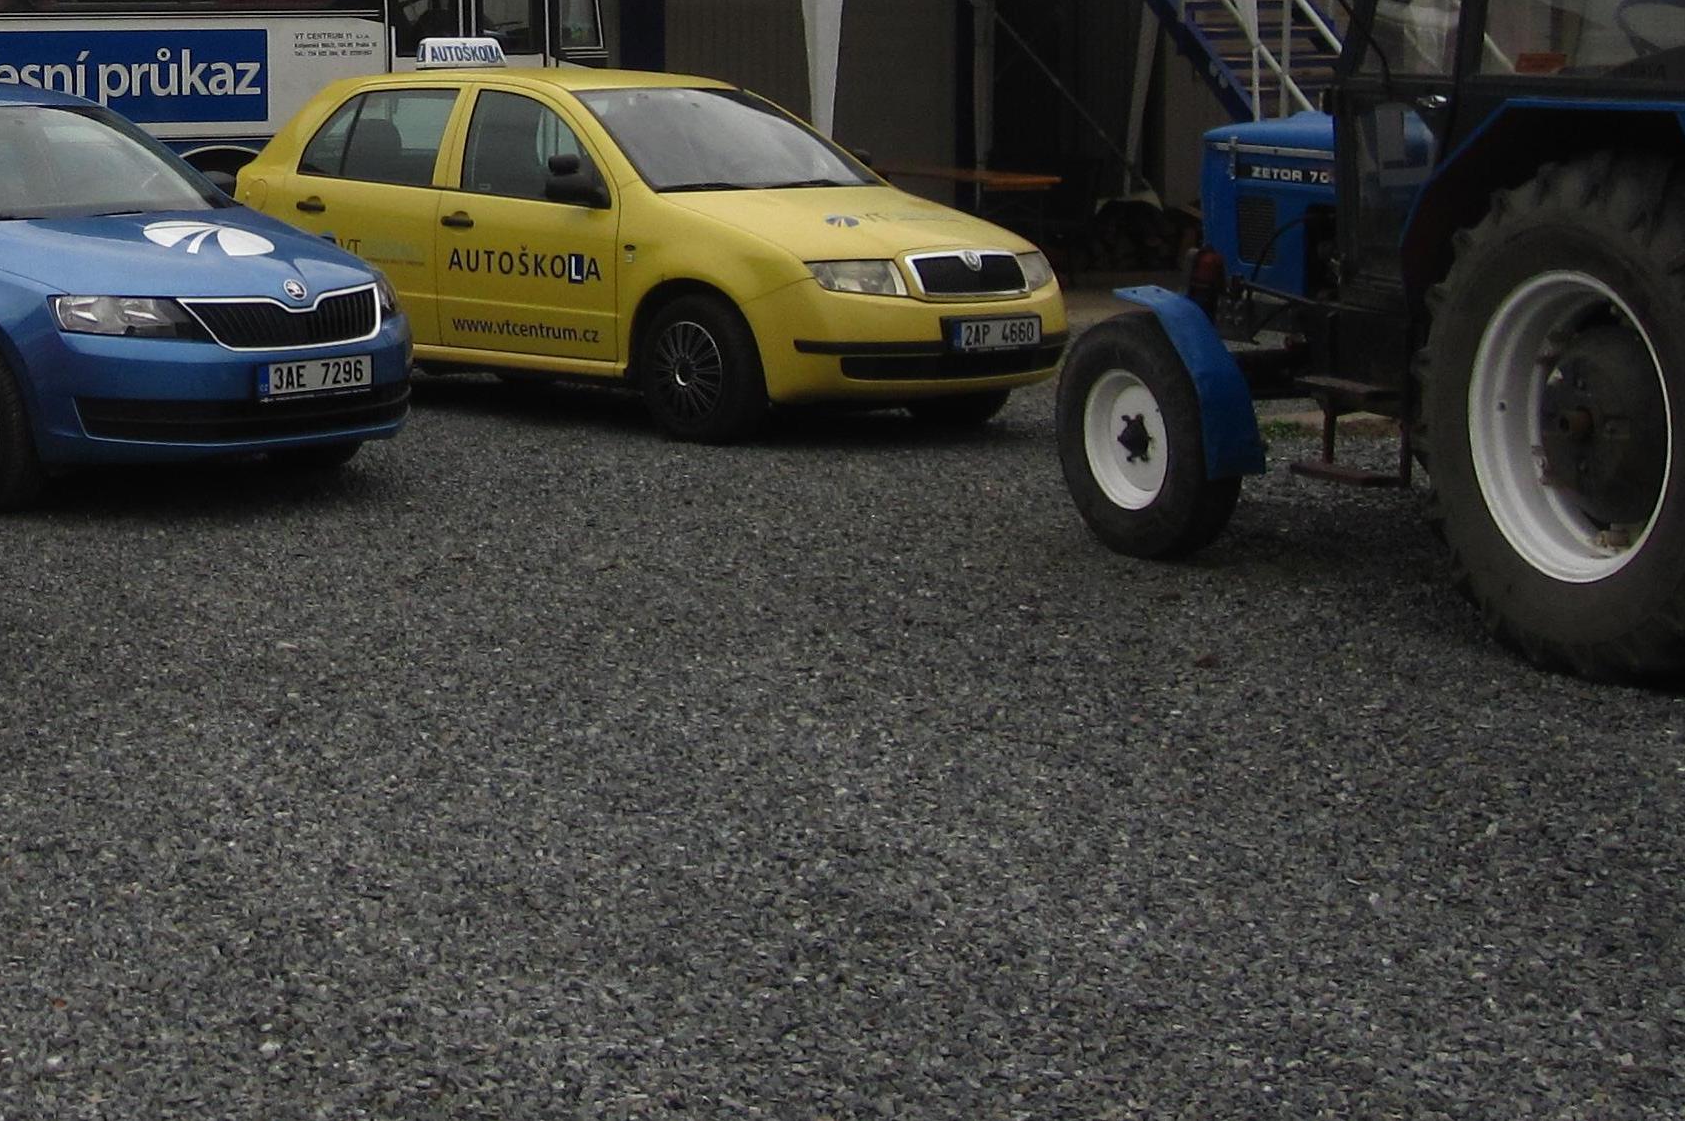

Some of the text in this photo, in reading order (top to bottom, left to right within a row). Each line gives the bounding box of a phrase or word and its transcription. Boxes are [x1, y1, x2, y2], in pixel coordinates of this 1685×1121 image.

[431, 43, 505, 63] AUTOŠKOLA
[98, 47, 261, 108] průkaz
[1251, 165, 1303, 182] ZETOR
[448, 244, 602, 283] AUTOŠKOLA
[452, 317, 600, 344] www.vtcentrum.cz
[964, 321, 1035, 347] 2AP 4660
[273, 359, 364, 391] 3AE 7296
